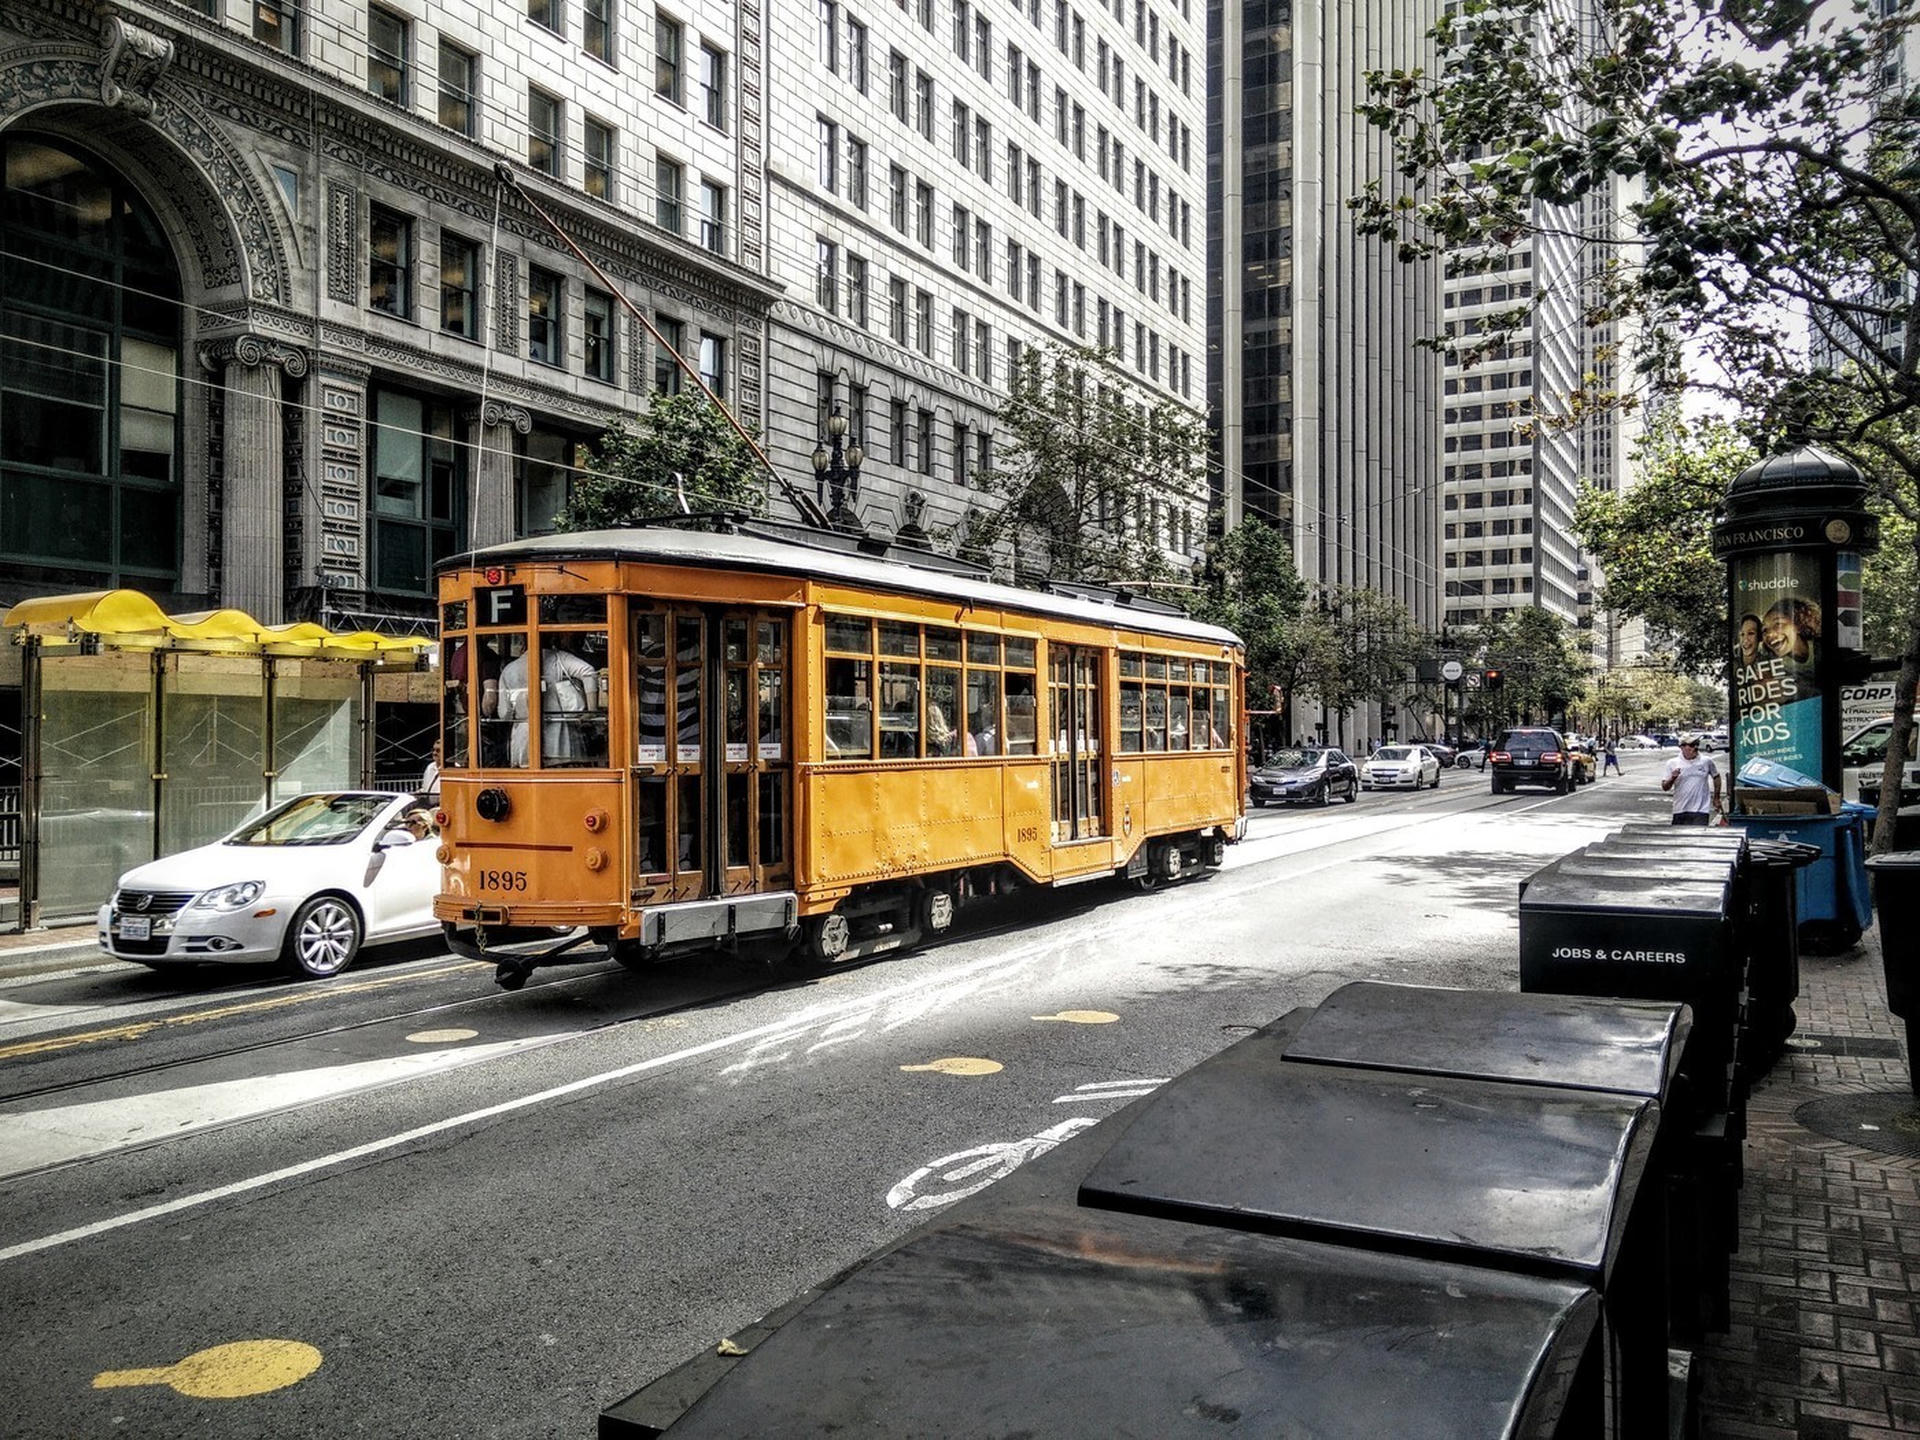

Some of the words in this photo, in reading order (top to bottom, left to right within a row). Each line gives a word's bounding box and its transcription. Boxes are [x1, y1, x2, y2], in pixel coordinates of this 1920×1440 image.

[1733, 527, 1804, 545] FRANCISCO
[1748, 577, 1799, 592] shuddle
[491, 590, 513, 623] F
[1736, 658, 1786, 686] SAFE
[1738, 678, 1798, 706] RIDES
[1841, 688, 1894, 701] CORP.
[1740, 702, 1782, 726] FOR
[1742, 722, 1791, 747] KIDS
[1017, 827, 1038, 843] 1895
[480, 870, 527, 891] 1895
[1552, 948, 1592, 960] JOBS
[1595, 949, 1607, 960] &
[1611, 950, 1686, 964] CAREERS
